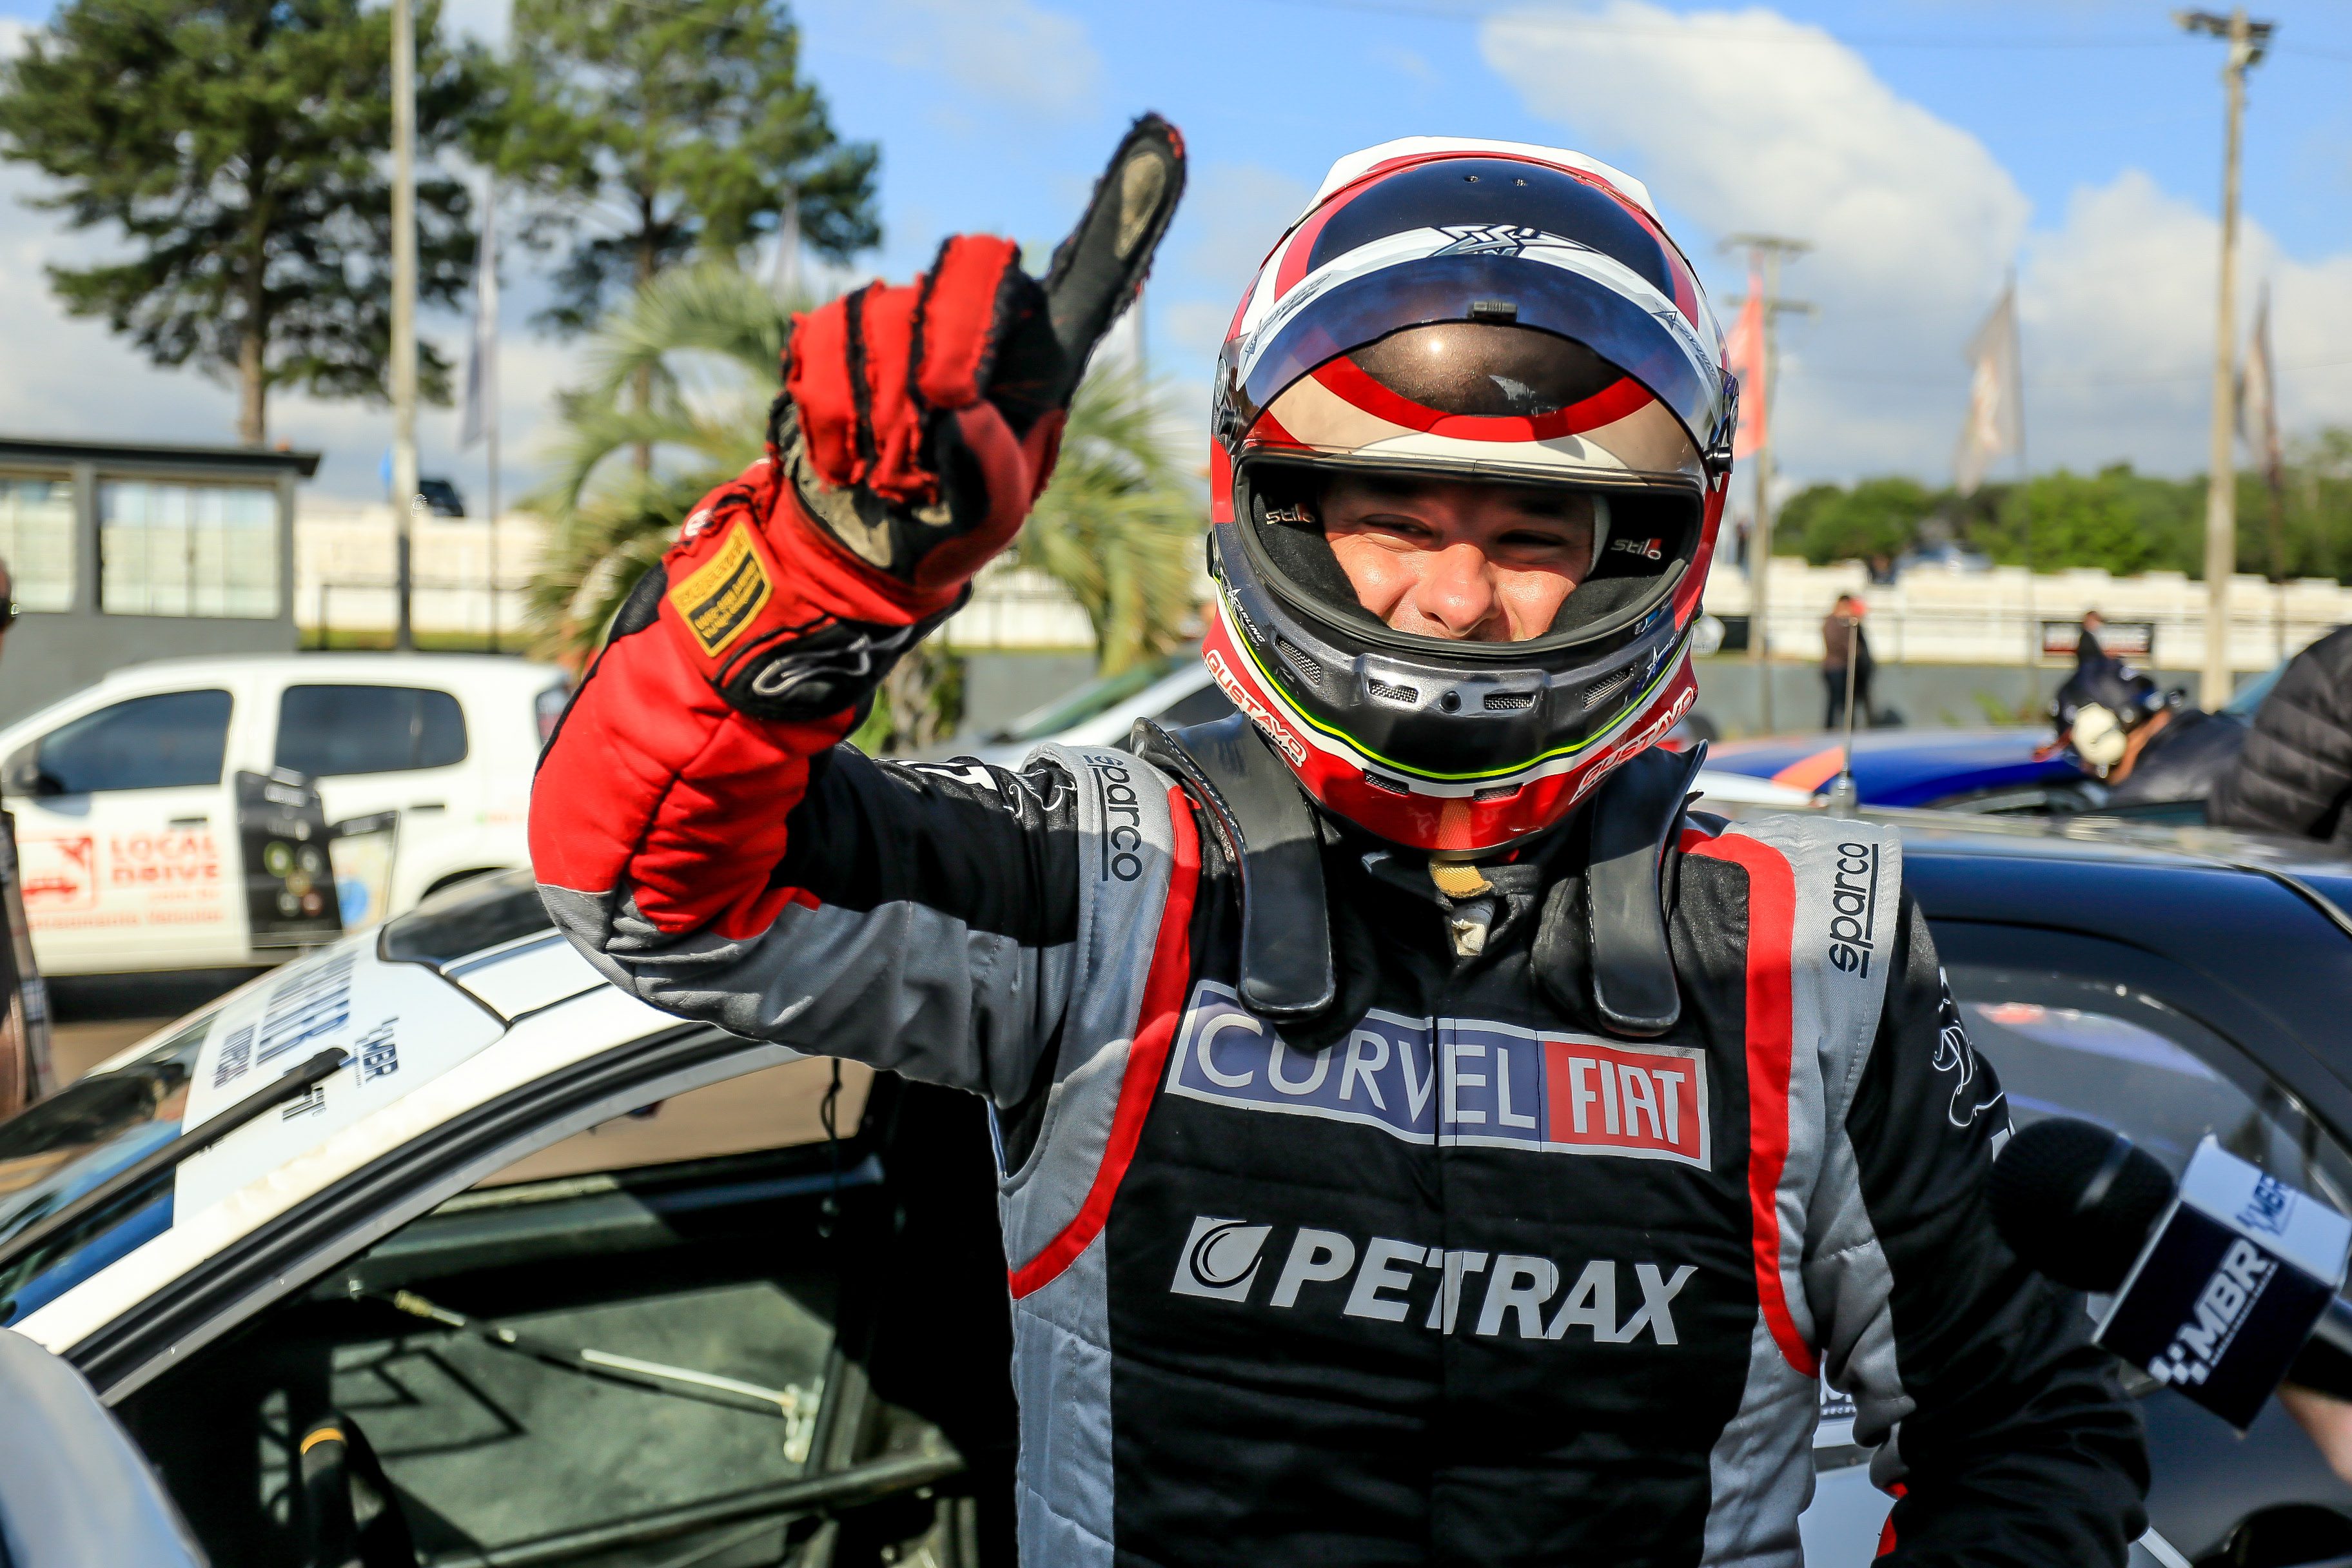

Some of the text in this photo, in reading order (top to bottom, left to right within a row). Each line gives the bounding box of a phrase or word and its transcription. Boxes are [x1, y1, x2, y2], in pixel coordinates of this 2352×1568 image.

[1207, 652, 1303, 757] GUSTAVO
[1582, 690, 1694, 786] GUSTAVO
[1086, 754, 1143, 882] sparco
[1828, 843, 1876, 976] sparco
[1197, 1013, 1685, 1145] CURVEL FIAT
[1269, 1227, 1699, 1345] PETRAX
[2176, 1237, 2268, 1360] MBR
